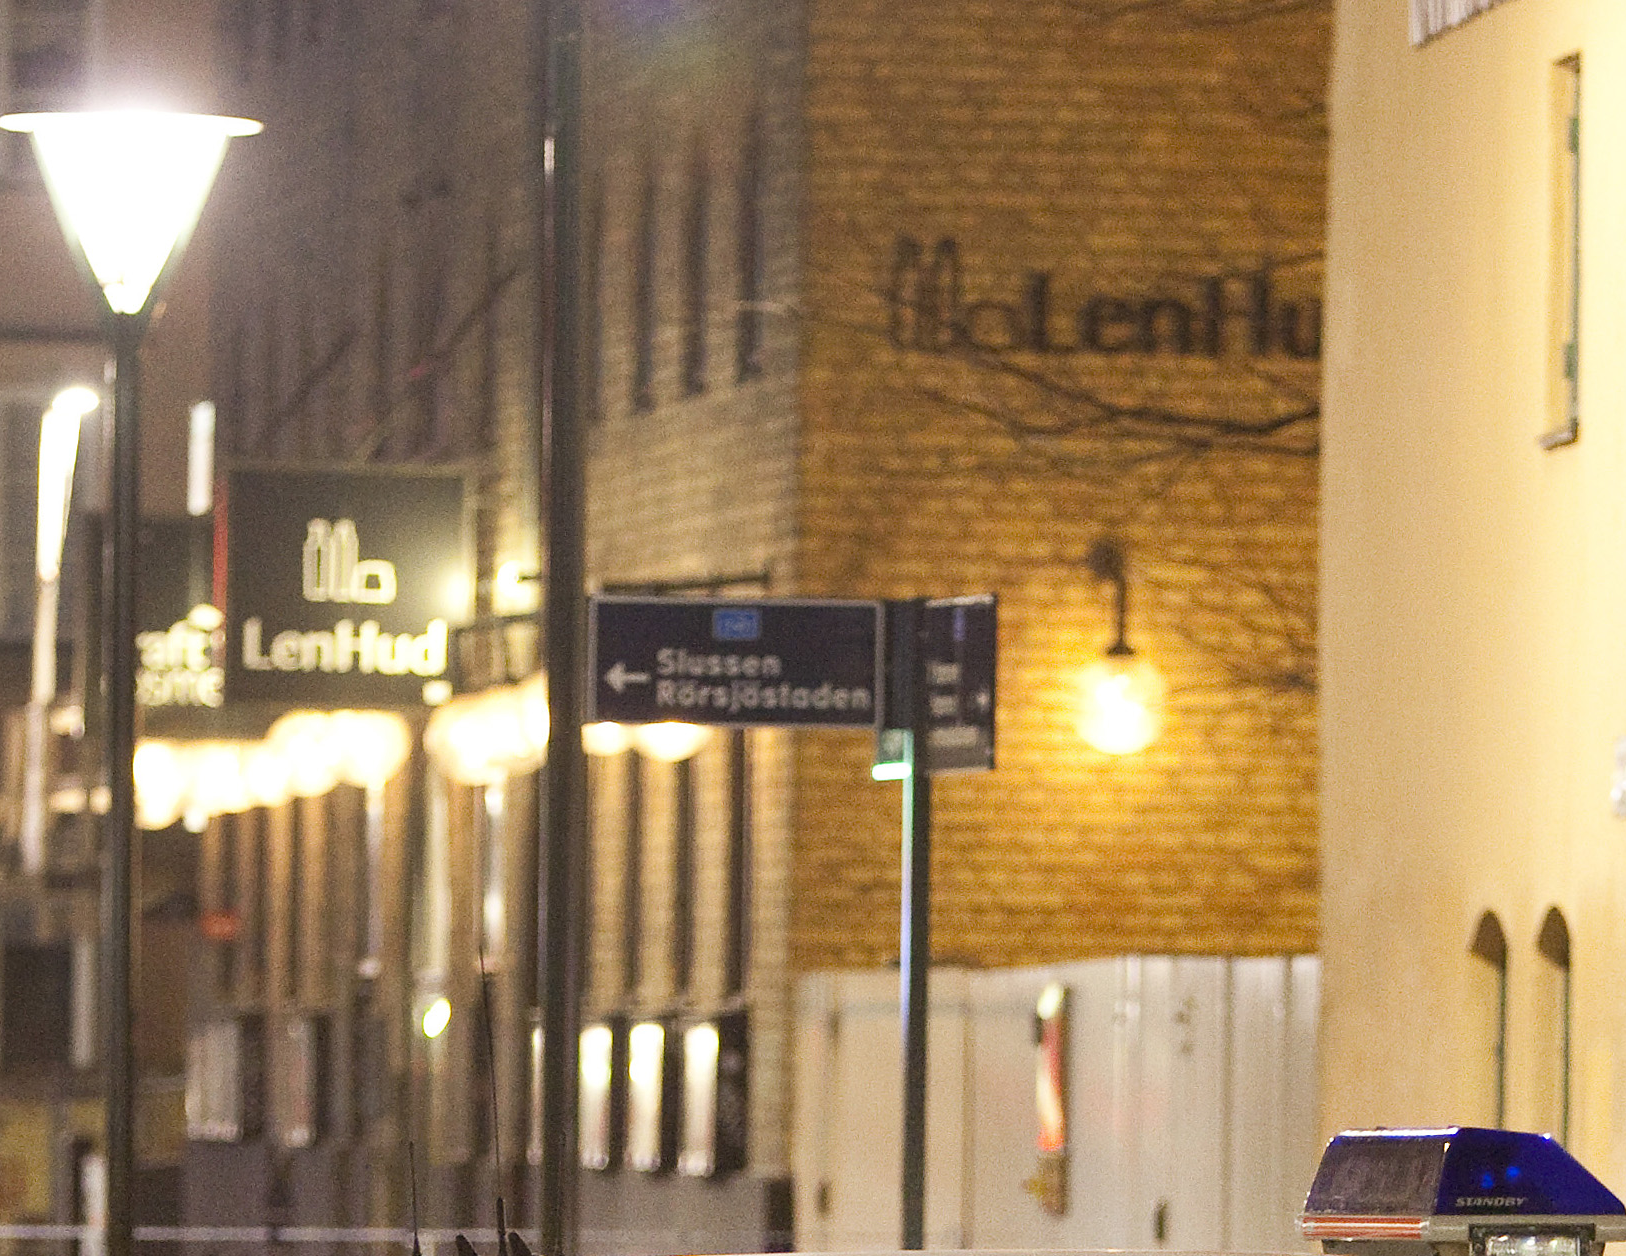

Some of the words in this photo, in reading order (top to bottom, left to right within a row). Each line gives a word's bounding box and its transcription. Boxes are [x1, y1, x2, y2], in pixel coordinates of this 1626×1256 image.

[1028, 269, 1322, 359] LenHu
[241, 616, 449, 677] LenHud
[655, 647, 783, 678] Slussen
